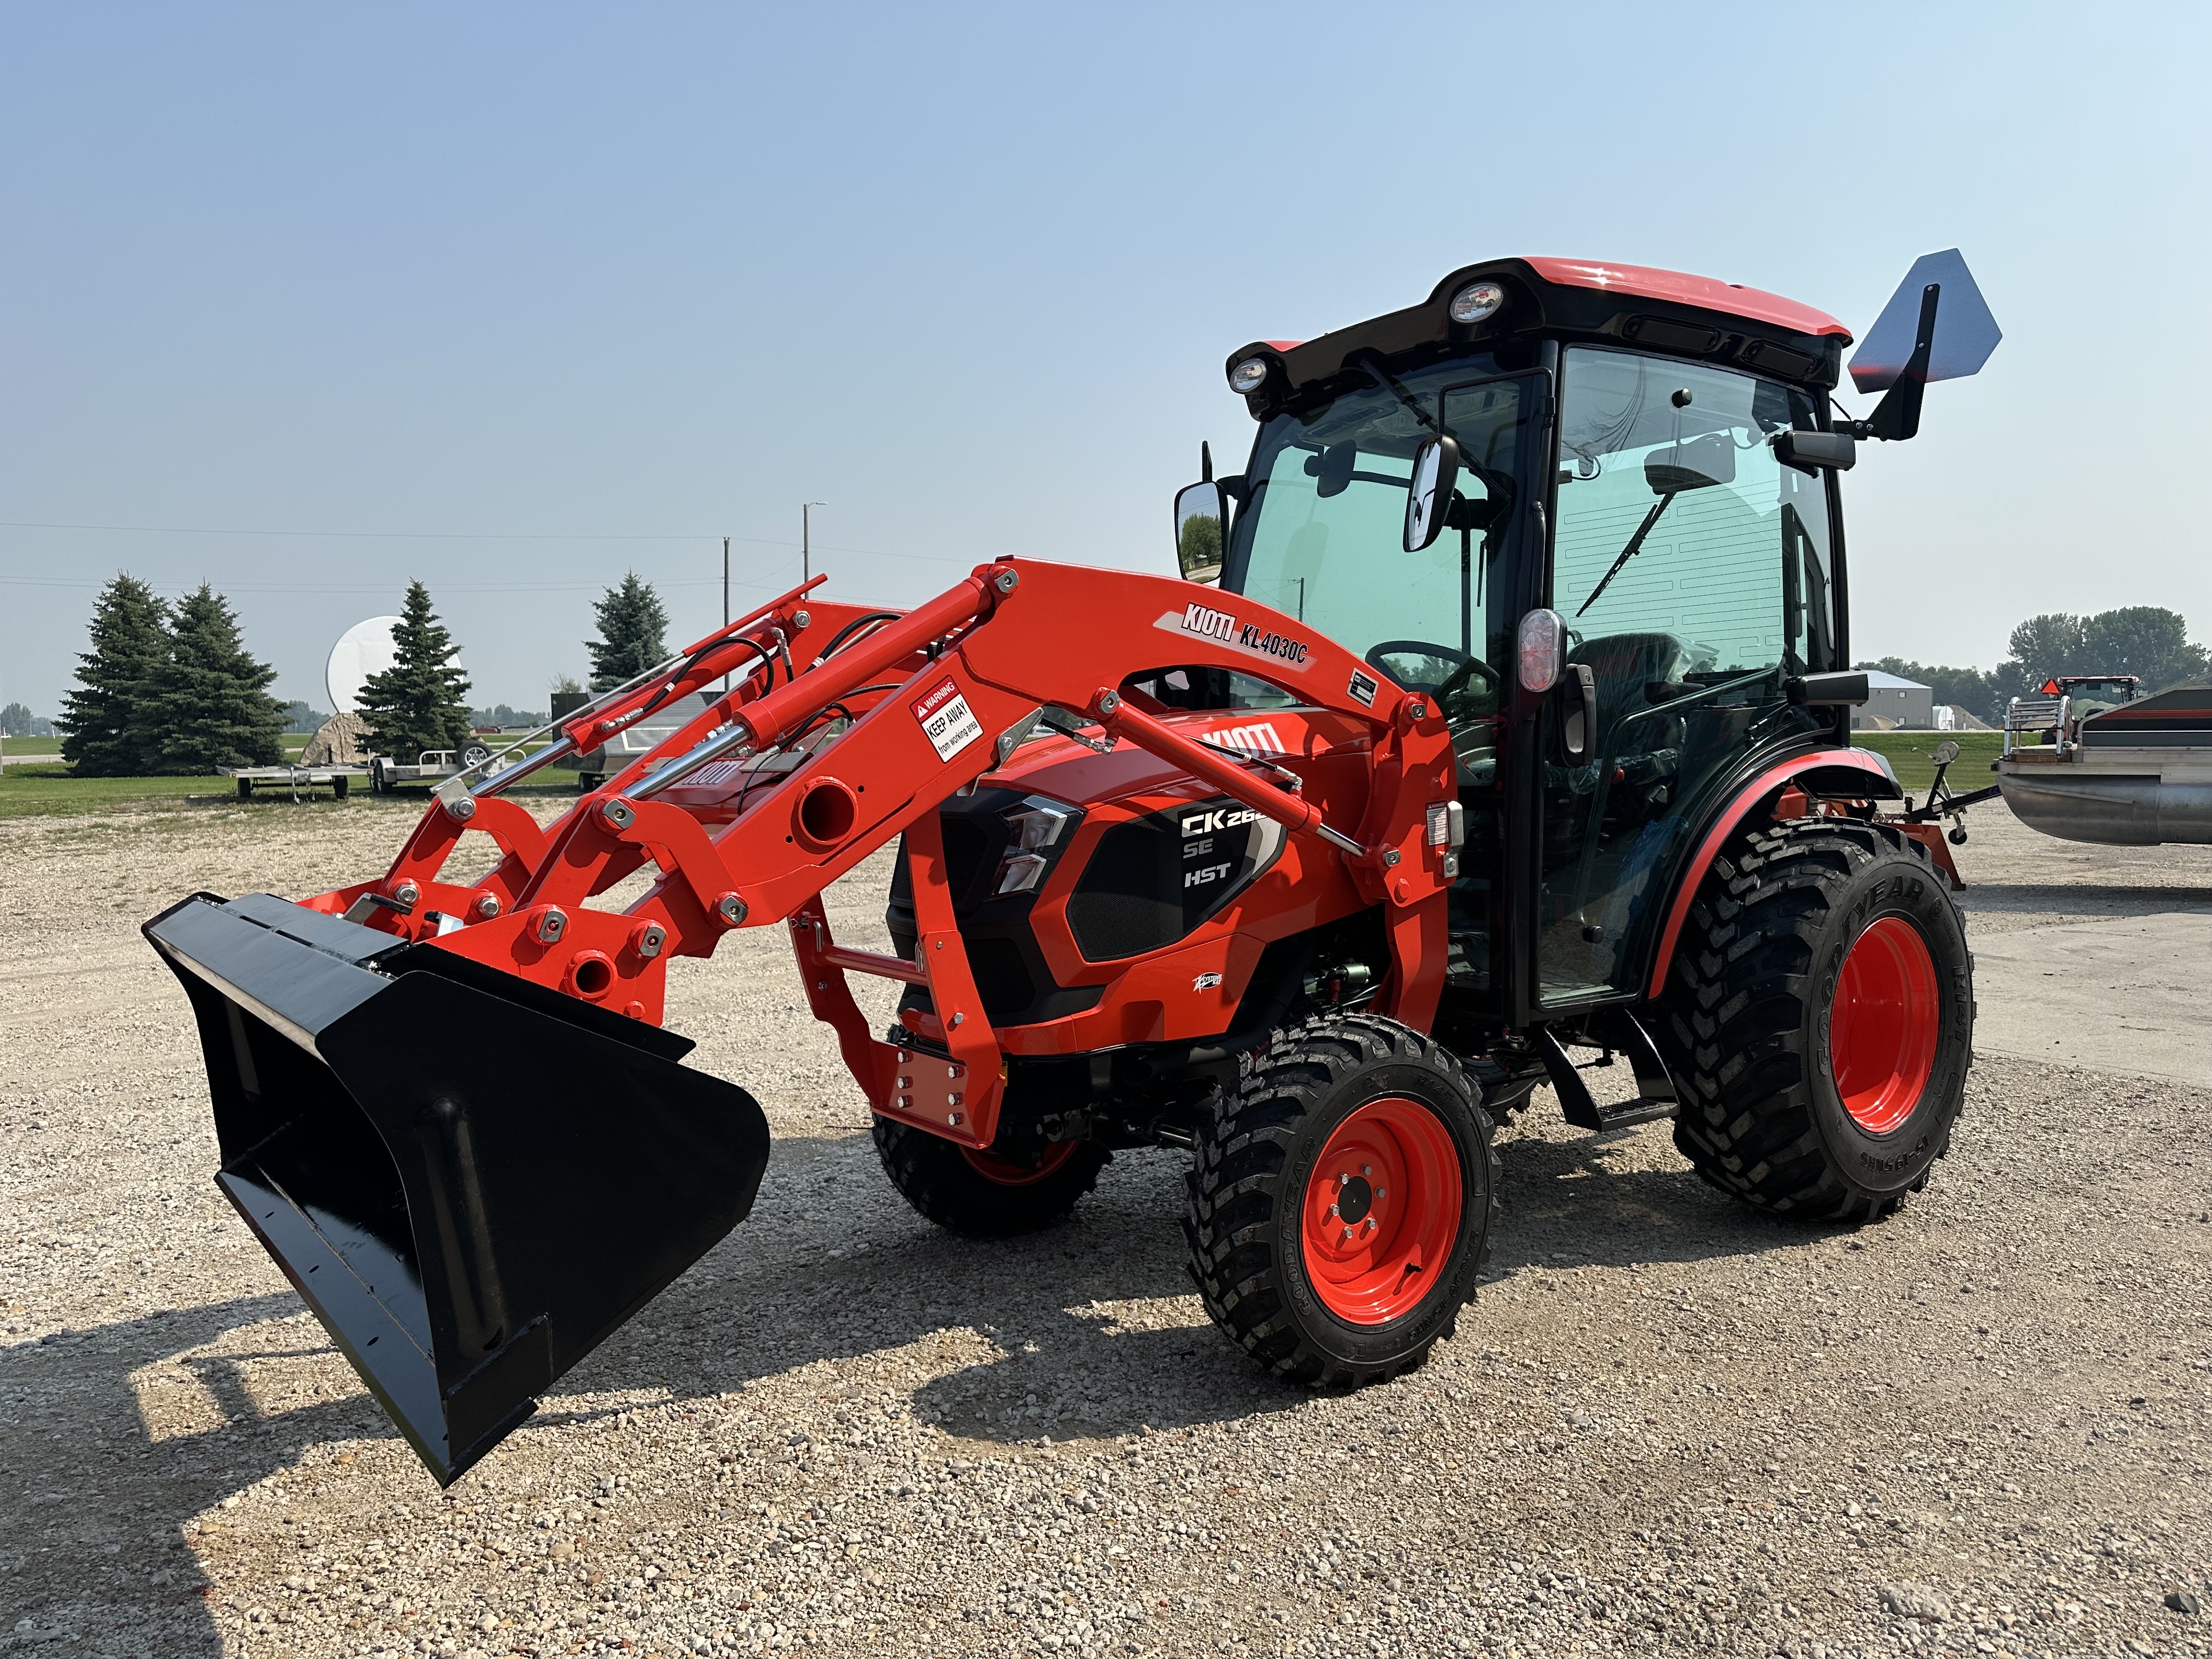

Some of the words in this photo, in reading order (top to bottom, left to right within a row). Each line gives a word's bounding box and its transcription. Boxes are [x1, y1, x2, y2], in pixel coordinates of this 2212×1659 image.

[1182, 602, 1236, 641] KIOTI
[1238, 623, 1308, 665] KL4030C
[923, 681, 956, 709] WARNING
[927, 716, 946, 740] KEEP
[946, 700, 968, 726] AWAY
[938, 742, 951, 755] from
[949, 730, 968, 746] working
[968, 720, 978, 734] area
[1183, 838, 1214, 859] SE
[1184, 862, 1231, 888] HST
[1816, 878, 1924, 1076] GOODYEAR
[1951, 965, 1968, 1048] R14T
[1282, 1136, 1317, 1316] GOODYEAR
